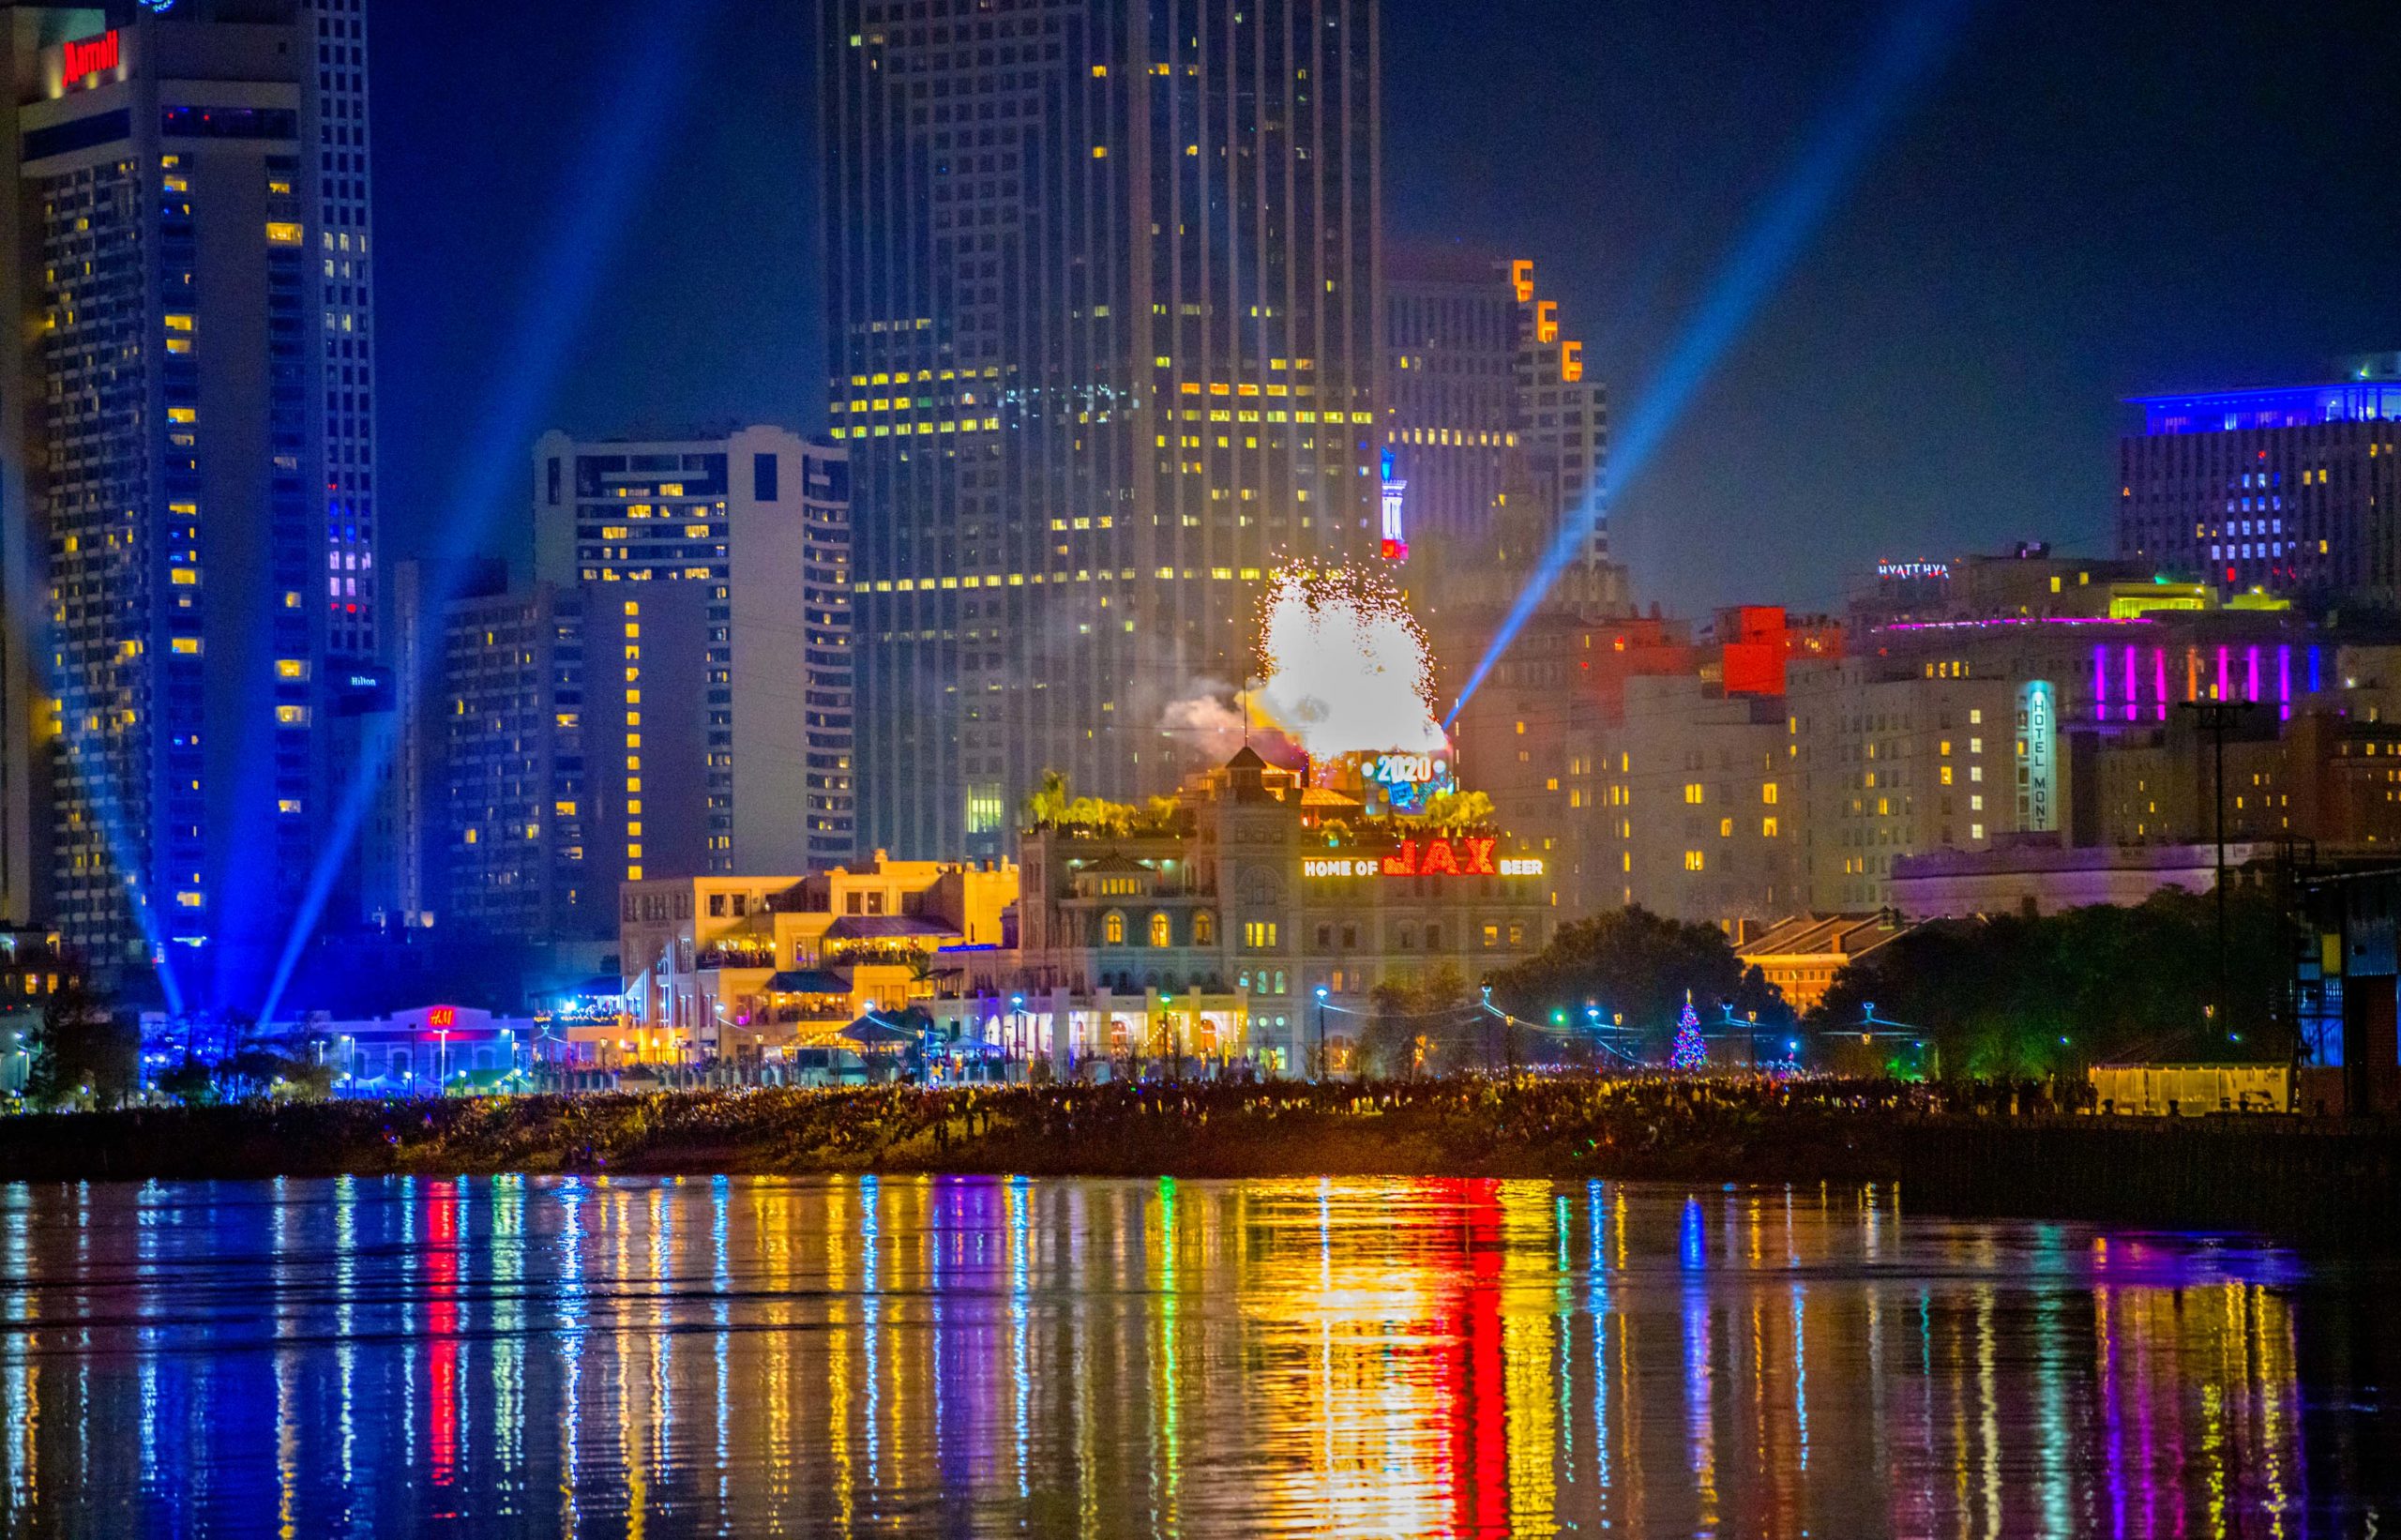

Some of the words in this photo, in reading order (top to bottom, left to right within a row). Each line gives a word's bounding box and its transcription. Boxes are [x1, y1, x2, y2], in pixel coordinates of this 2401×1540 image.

[1879, 564, 1921, 579] HYATT
[351, 676, 376, 686] Hilton
[2033, 701, 2045, 767] HOTEL
[1377, 755, 1431, 783] 2020
[1305, 861, 1352, 876] HOME
[1355, 861, 1379, 876] OF
[1382, 838, 1497, 876] JAX
[1500, 859, 1544, 875] BEER
